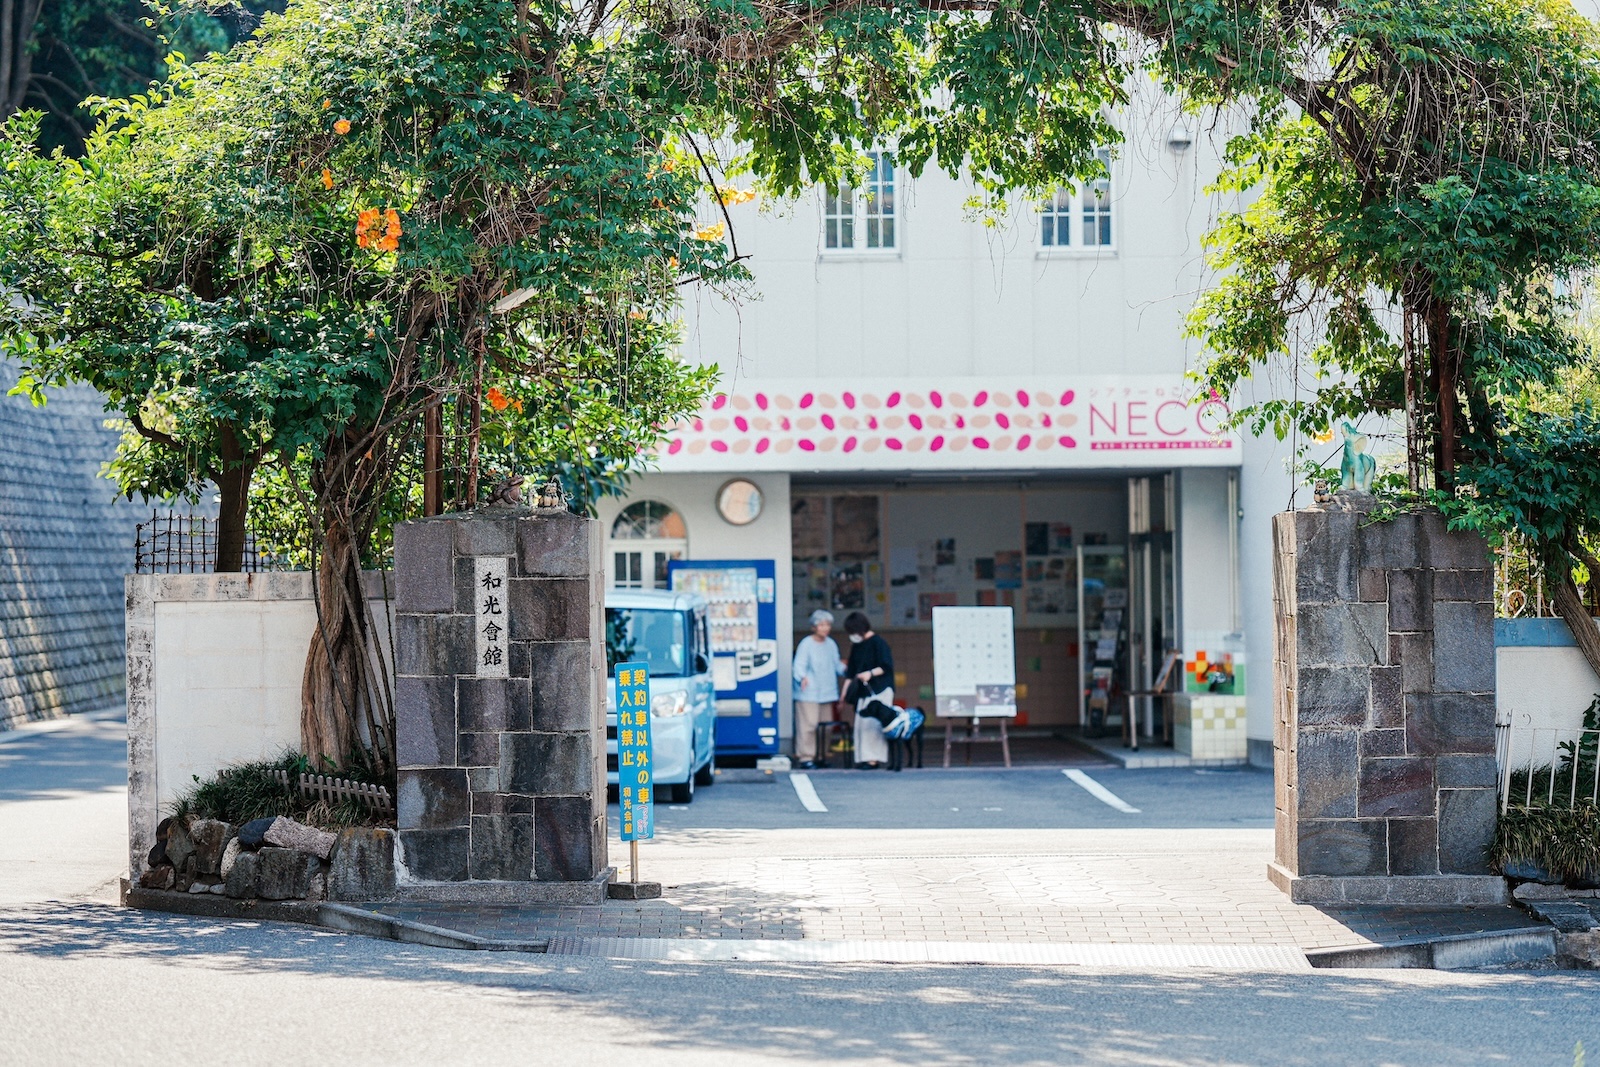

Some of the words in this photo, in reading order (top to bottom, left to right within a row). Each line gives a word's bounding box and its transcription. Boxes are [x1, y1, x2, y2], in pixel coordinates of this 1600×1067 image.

[1090, 400, 1231, 436] NECO
[481, 571, 503, 666] 和光會館
[618, 669, 635, 767] 乗入れ禁止
[633, 669, 649, 805] 契約車以外の車
